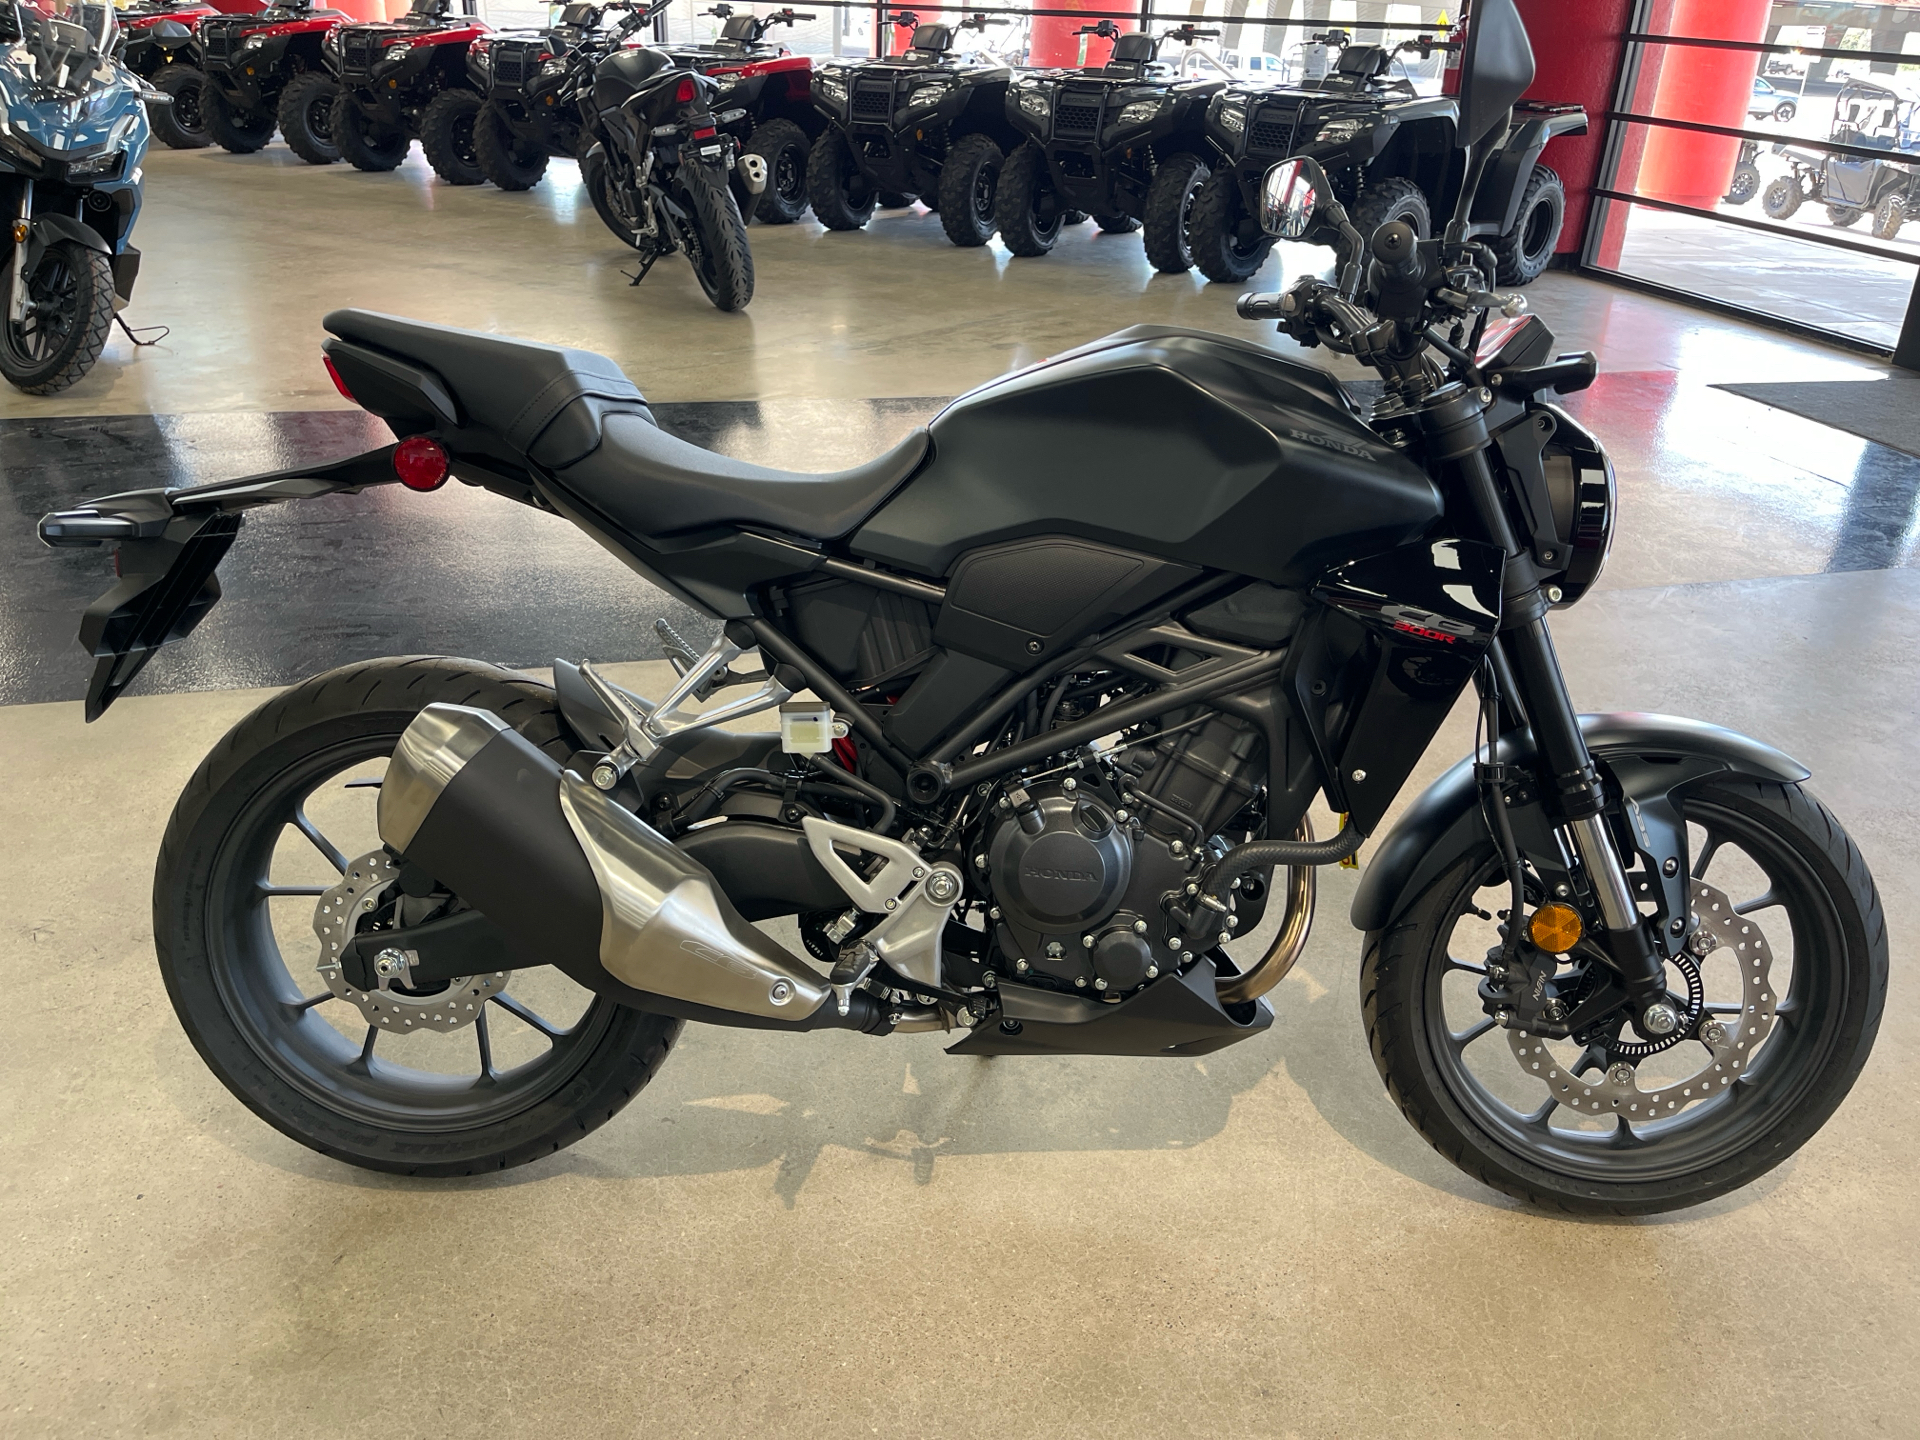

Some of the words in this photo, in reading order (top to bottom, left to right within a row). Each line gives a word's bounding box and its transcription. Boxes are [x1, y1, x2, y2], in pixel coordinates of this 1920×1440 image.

[1290, 428, 1377, 461] HONDA
[1381, 605, 1476, 635] CB
[1394, 620, 1456, 644] 300R
[1629, 796, 1651, 848] ABS
[1024, 866, 1099, 882] HONDA
